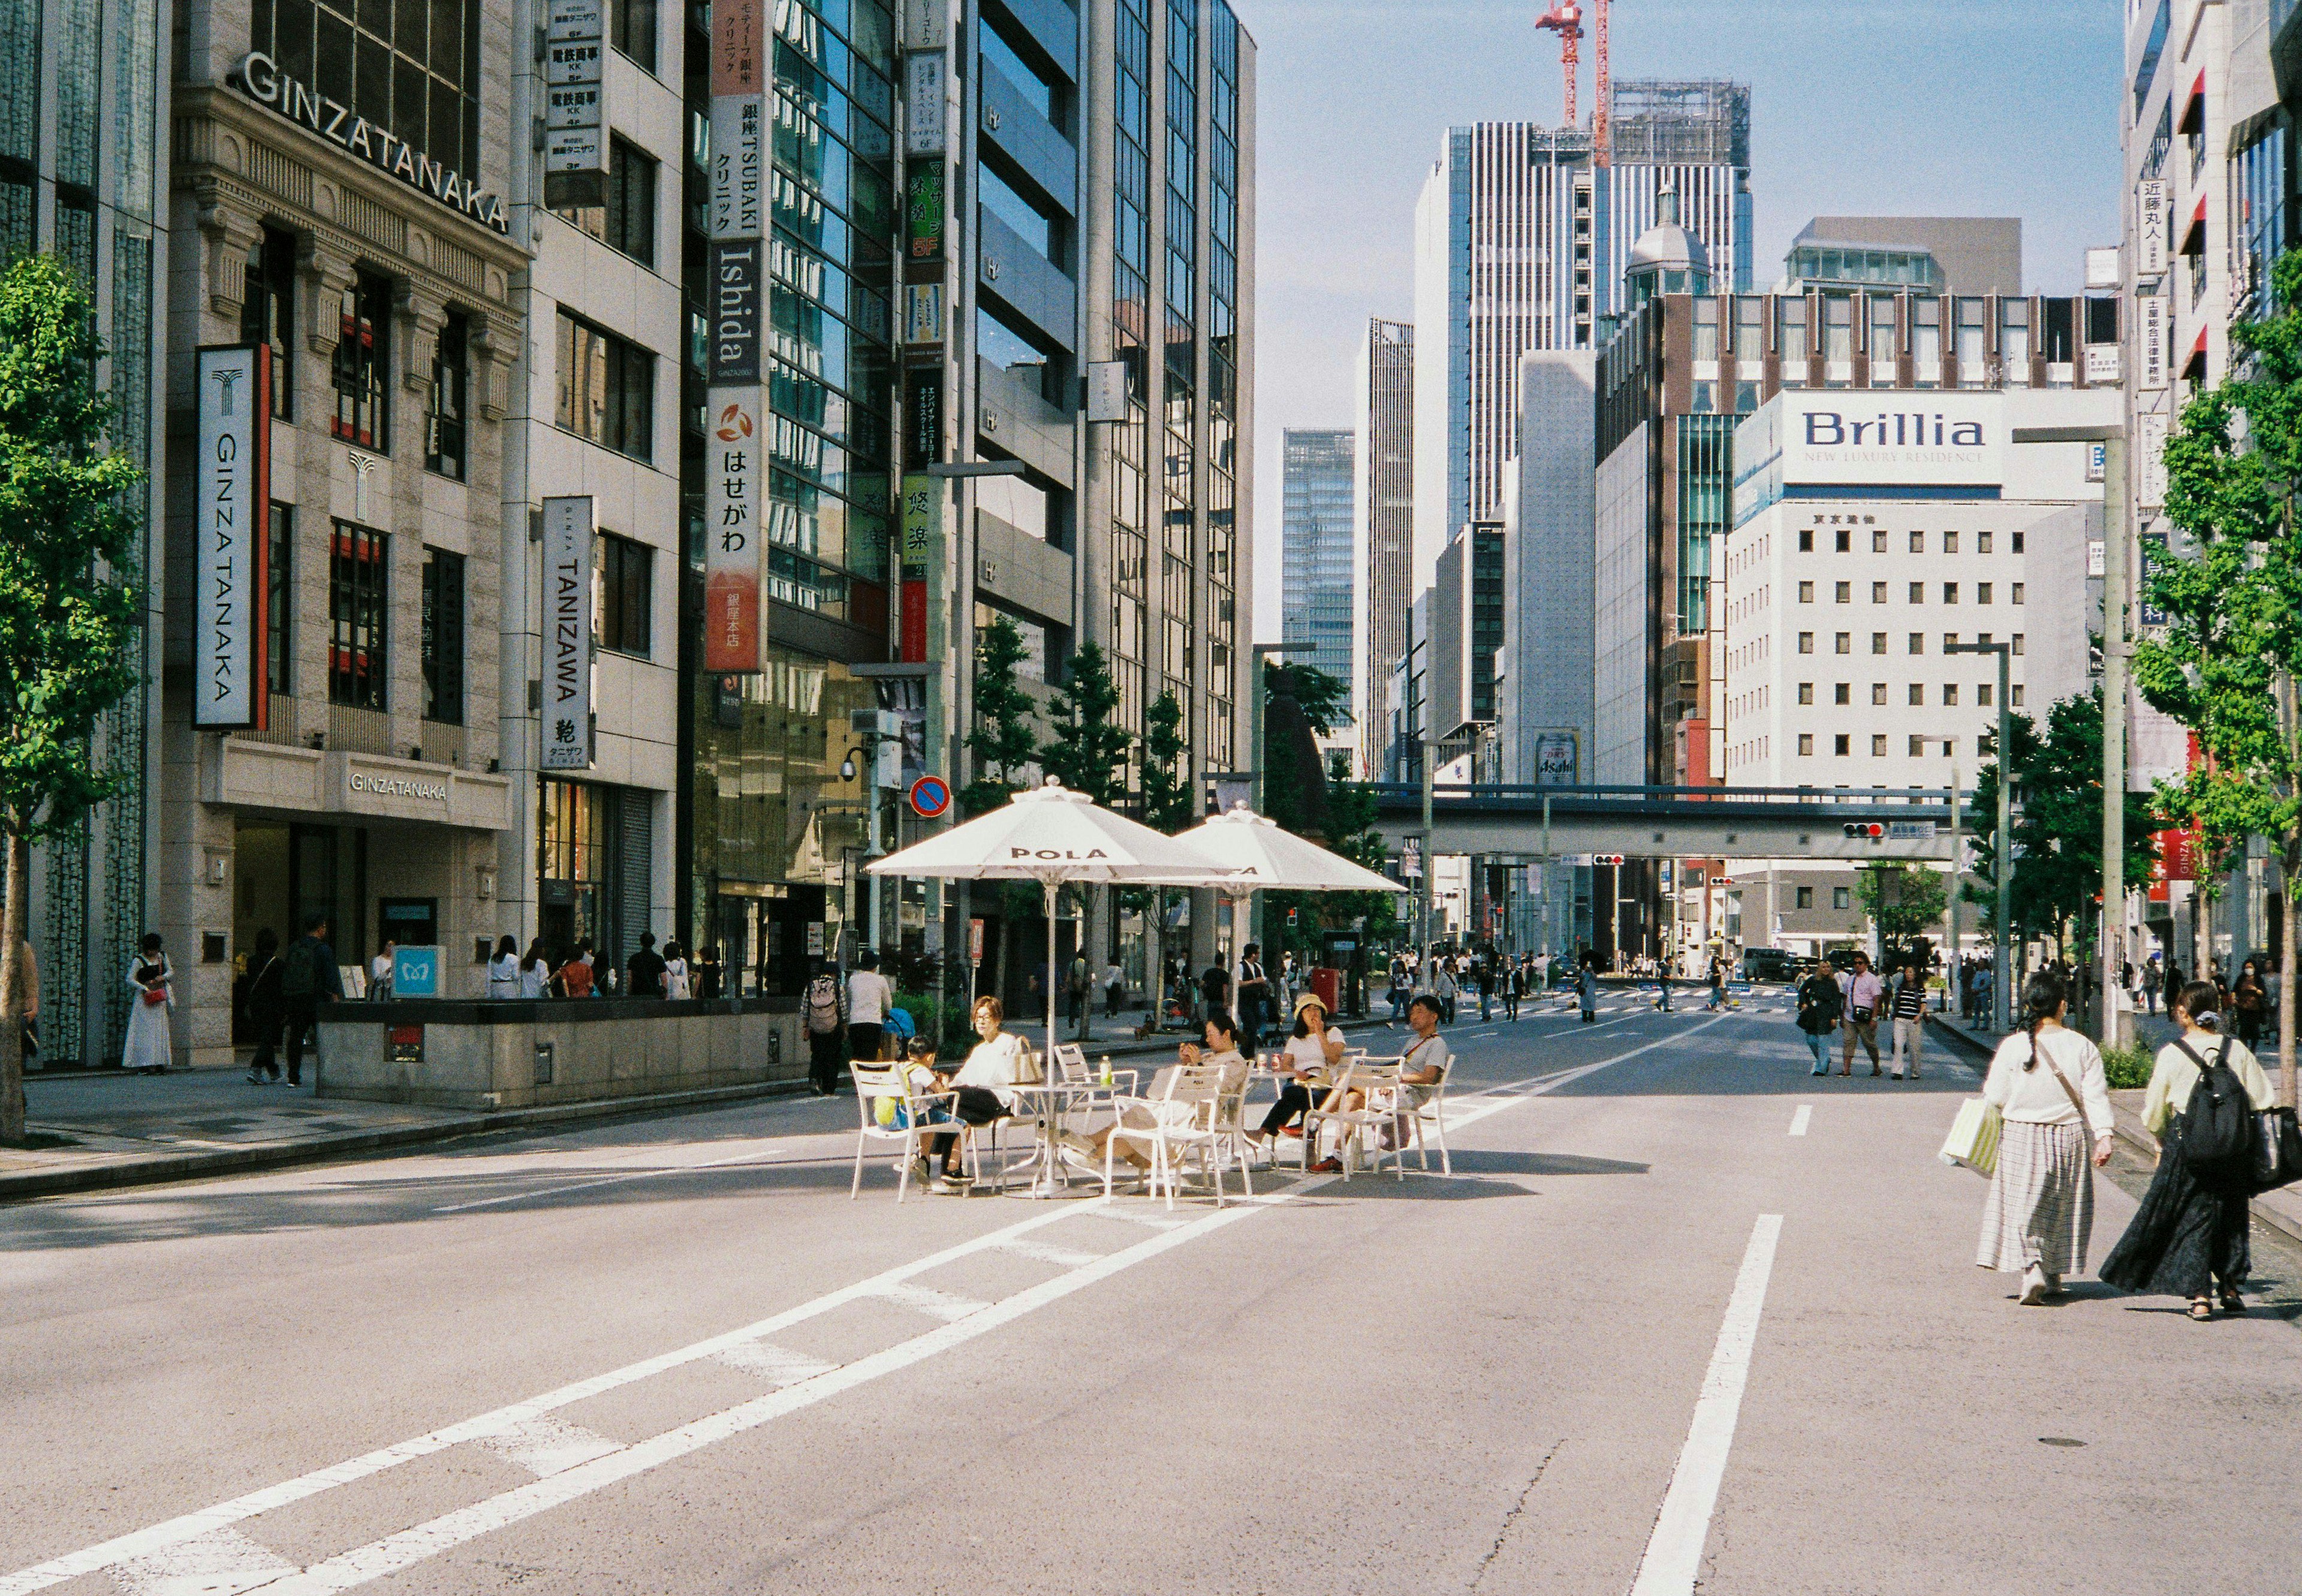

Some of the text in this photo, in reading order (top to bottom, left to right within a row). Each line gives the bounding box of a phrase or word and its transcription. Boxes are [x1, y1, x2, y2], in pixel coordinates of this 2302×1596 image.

[555, 13, 596, 23] 銀座タニザワ
[724, 16, 735, 72] クリニック
[553, 47, 598, 63] 電鉄商事
[552, 91, 596, 107] 電鉄商事
[244, 52, 508, 233] GINZATANAKA
[552, 145, 595, 155] 銀座タニザワ
[742, 104, 758, 230] 銀座TSUBAKI
[716, 153, 731, 231] クリニック
[930, 161, 942, 234] マッサージ
[2145, 183, 2161, 239] 近藤丸人
[720, 248, 752, 363] Ishida
[1803, 412, 1986, 445] Brillia
[1805, 453, 1982, 463] NEW LUXURY RESIDENCE
[721, 451, 747, 552] はせがわ
[908, 491, 927, 550] 悠楽
[215, 433, 236, 702] GINZATANAKA
[557, 559, 577, 702] TANIZAWA
[726, 593, 739, 647] 銀座本店
[550, 747, 581, 756] タニザワ
[1540, 759, 1573, 774] Asahi
[351, 773, 446, 801] GINZATANAKA
[1011, 847, 1107, 859] POLA
[2180, 840, 2189, 874] GINZA
